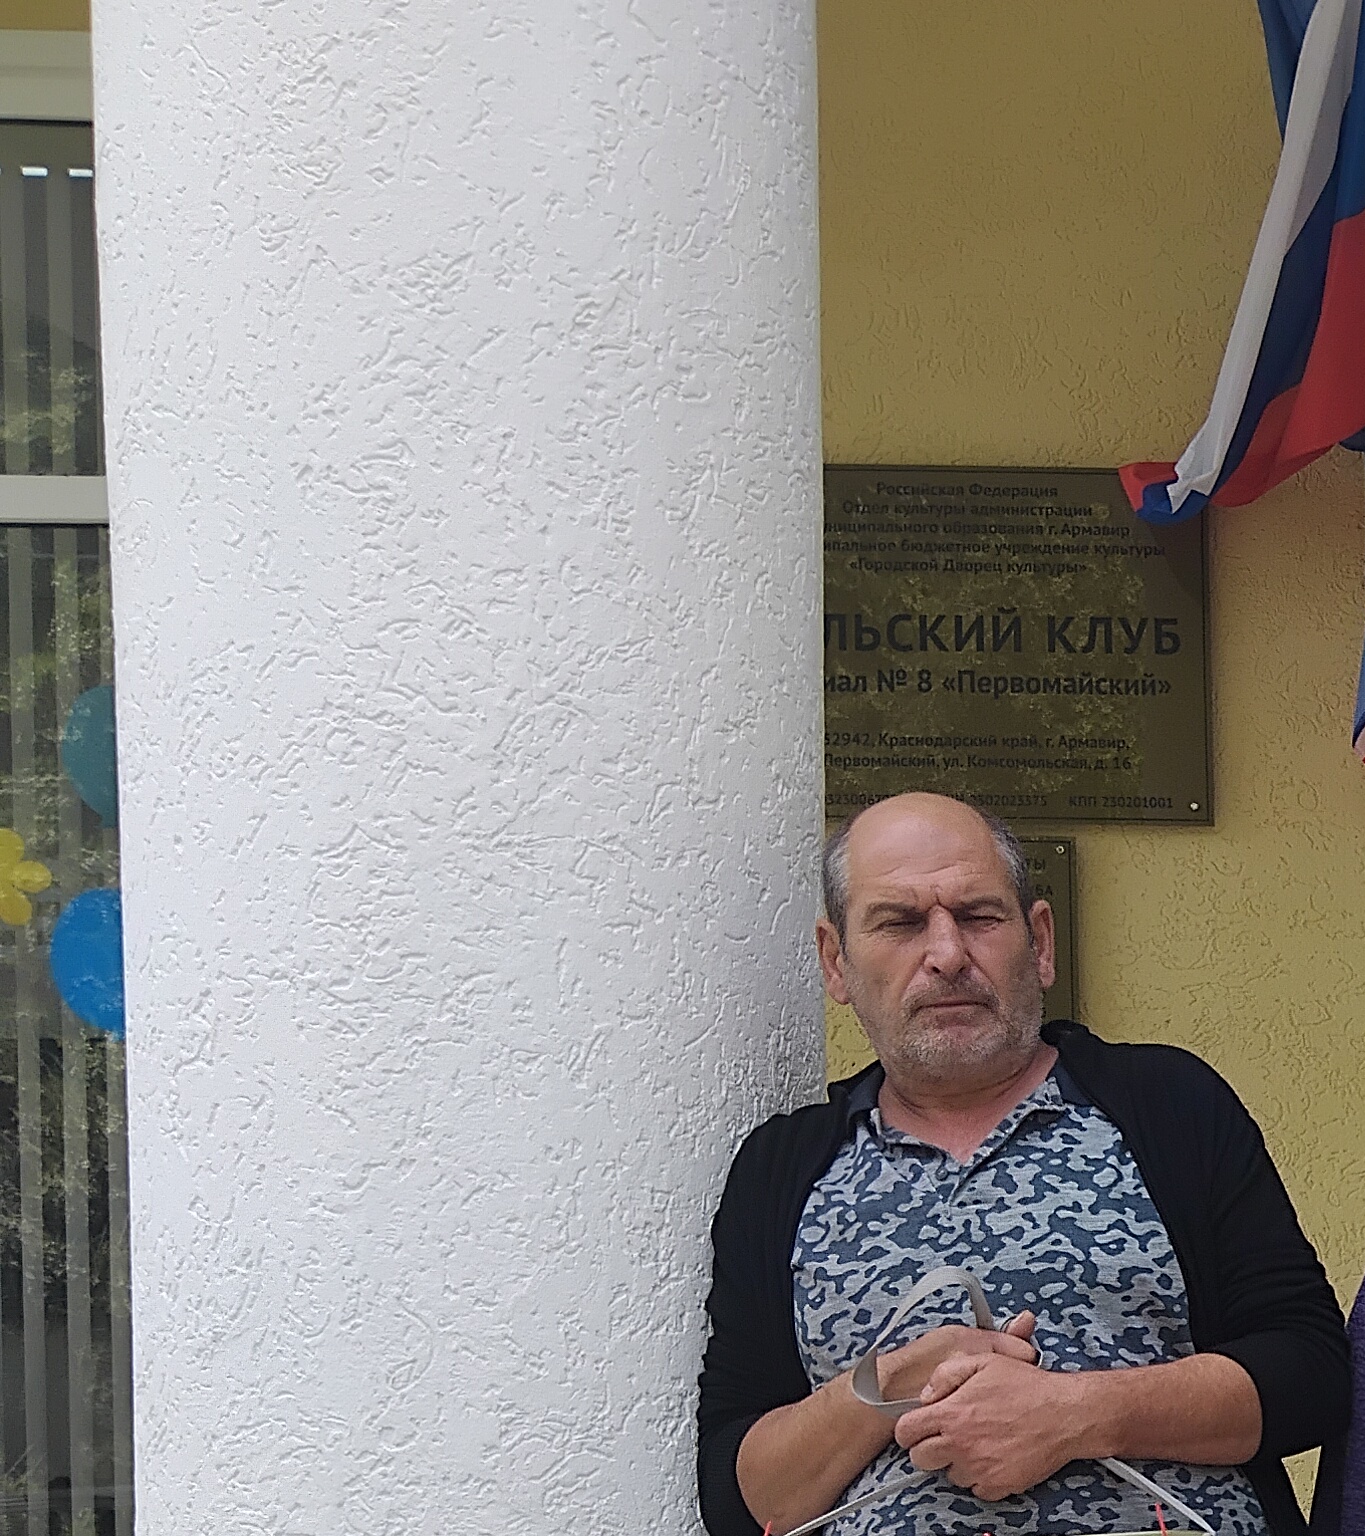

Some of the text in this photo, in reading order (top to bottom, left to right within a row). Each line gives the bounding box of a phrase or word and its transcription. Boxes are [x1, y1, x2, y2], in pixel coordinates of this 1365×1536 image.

[877, 482, 1058, 499] Российская Федерация
[843, 501, 1093, 518] Отдел культуры администрации
[943, 521, 1044, 535] образования
[1060, 523, 1130, 538] Армавир
[902, 539, 990, 553] бюджетное
[994, 542, 1089, 556] учреждение
[1094, 545, 1166, 558] культуры
[850, 557, 1087, 577] «Городской Дворец культуры»
[1048, 616, 1181, 656] КЛУБ
[877, 668, 907, 693] №
[917, 669, 932, 693] 8
[942, 671, 1171, 699] «Первомайский»
[878, 732, 997, 750] Краснодарский
[1058, 735, 1131, 750] Армавир,
[942, 758, 963, 771] ул.
[1113, 756, 1132, 770] 16
